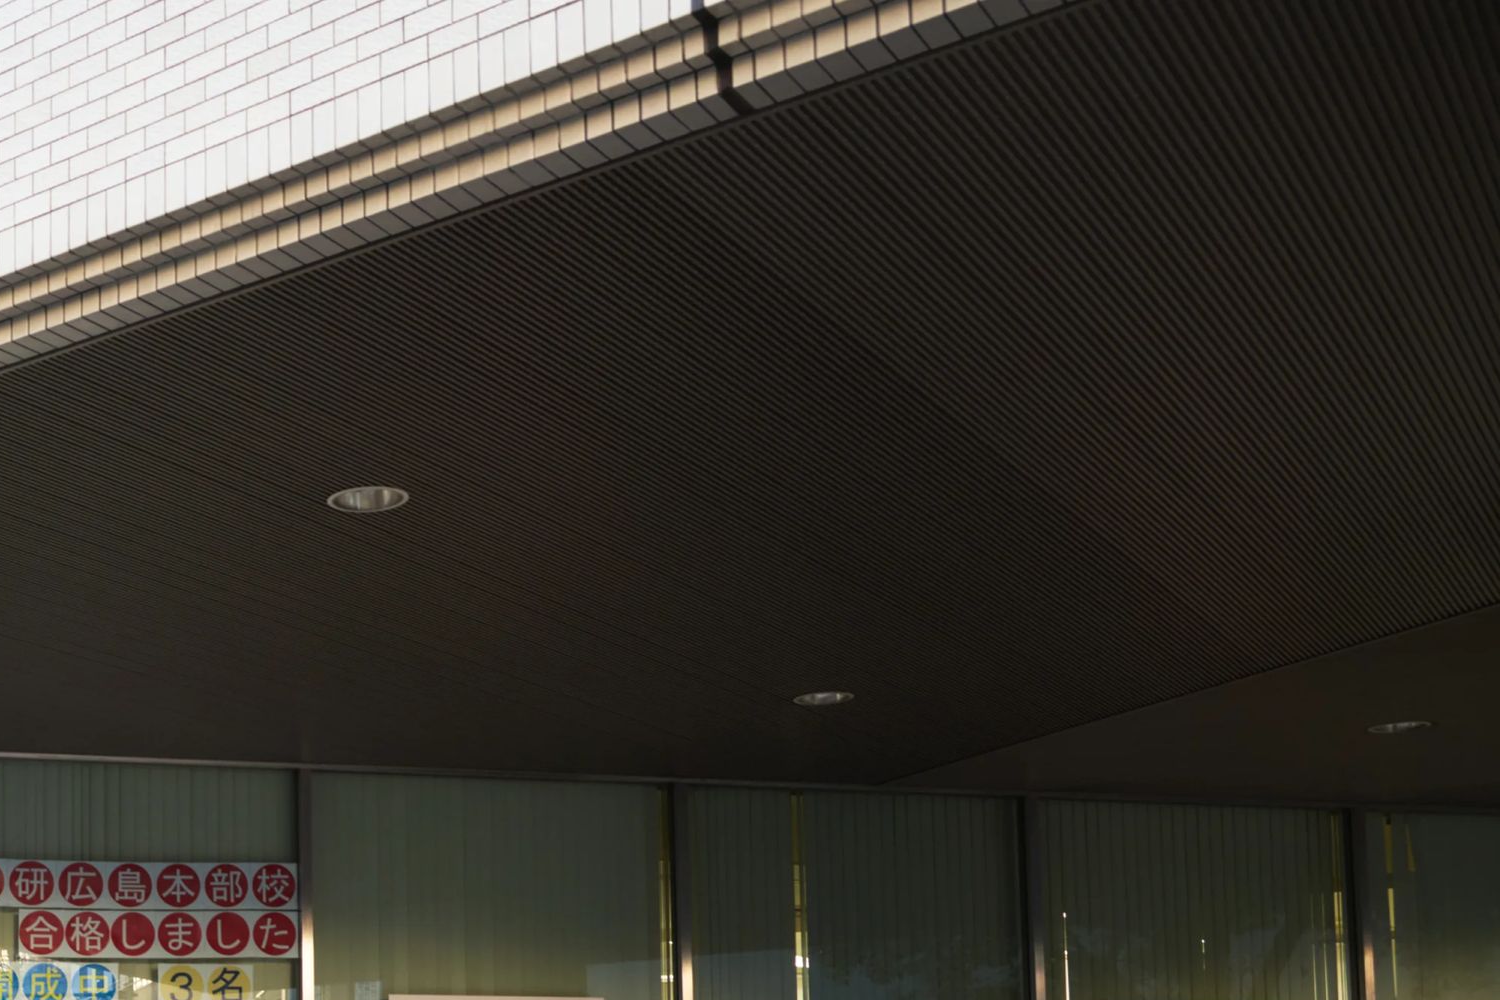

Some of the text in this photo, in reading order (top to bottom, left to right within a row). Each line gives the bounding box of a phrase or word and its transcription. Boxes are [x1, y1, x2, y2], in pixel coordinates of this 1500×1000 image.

[24, 916, 291, 952] 合格しました
